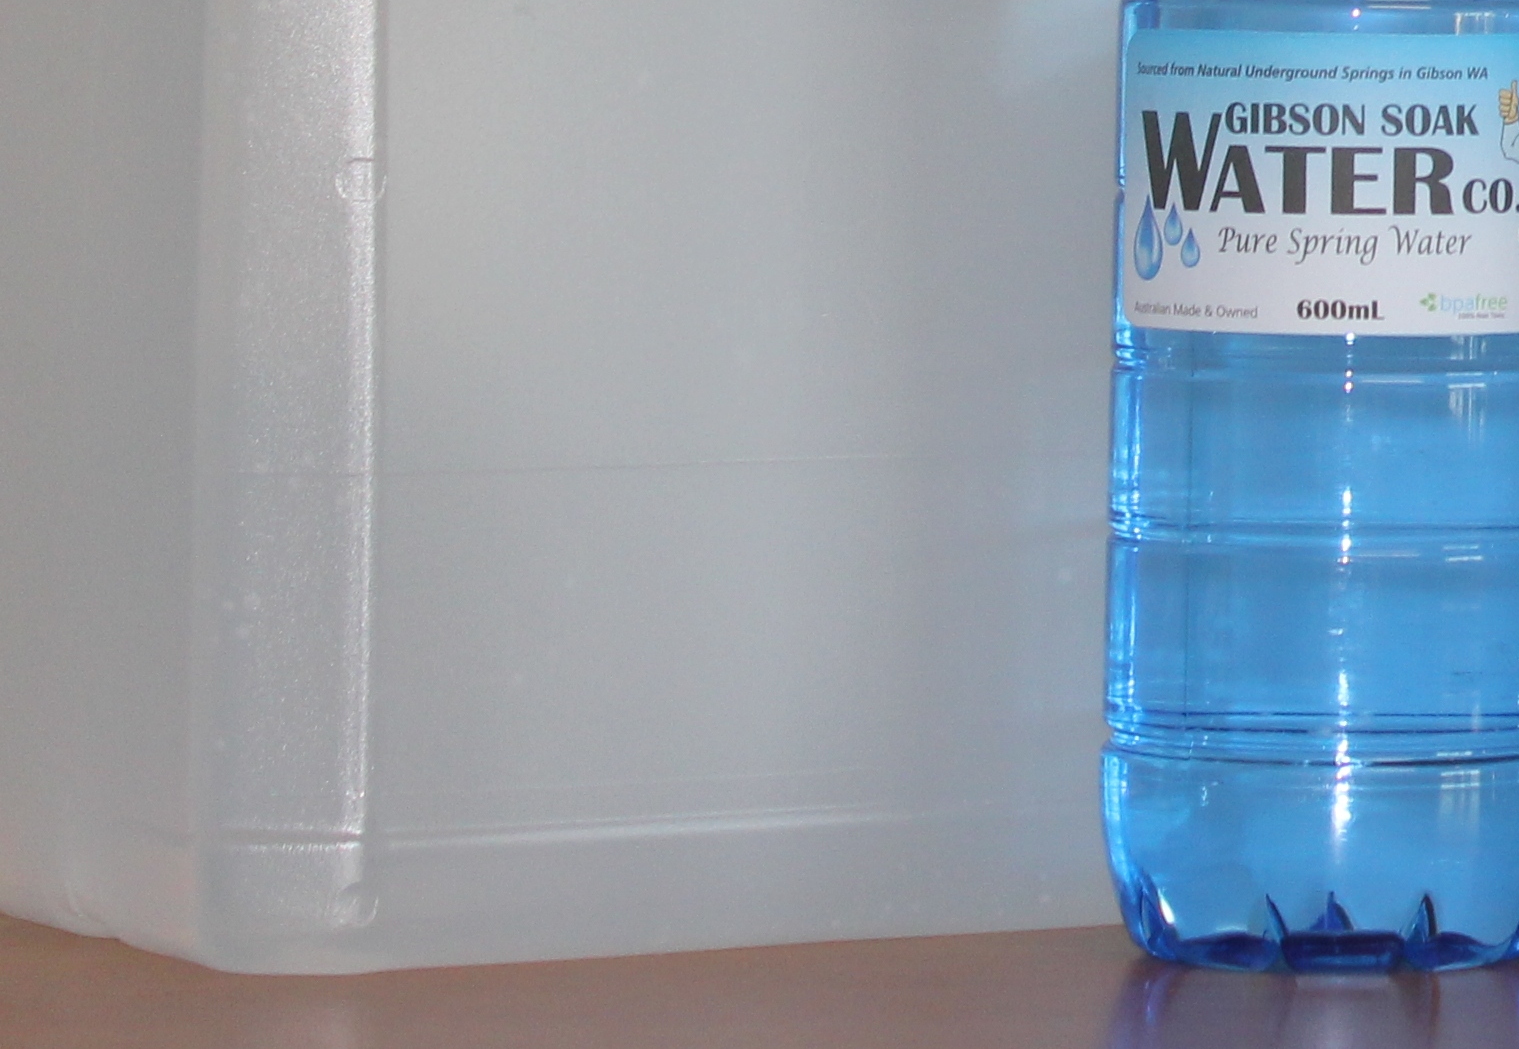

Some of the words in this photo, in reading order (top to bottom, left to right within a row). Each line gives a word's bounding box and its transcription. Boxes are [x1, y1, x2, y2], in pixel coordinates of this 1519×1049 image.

[1137, 62, 1167, 76] Sourced
[1169, 63, 1195, 77] from
[1197, 63, 1242, 78] Natural
[1245, 65, 1337, 82] Underground
[1342, 66, 1394, 82] Springs
[1399, 67, 1412, 79] in
[1416, 67, 1463, 80] Gibson
[1467, 68, 1488, 80] WA
[1225, 102, 1365, 136] GIBSON
[1381, 104, 1479, 136] SOAK
[1142, 110, 1455, 216] WATER
[1218, 228, 1277, 254] Pure
[1287, 228, 1378, 265] Spring
[1391, 226, 1472, 255] Water
[1134, 301, 1171, 317] Australian
[1173, 304, 1201, 317] Made
[1204, 305, 1214, 318] &
[1217, 305, 1258, 319] Owned
[1297, 299, 1385, 321] 600mL
[1441, 293, 1507, 313] bpafree
